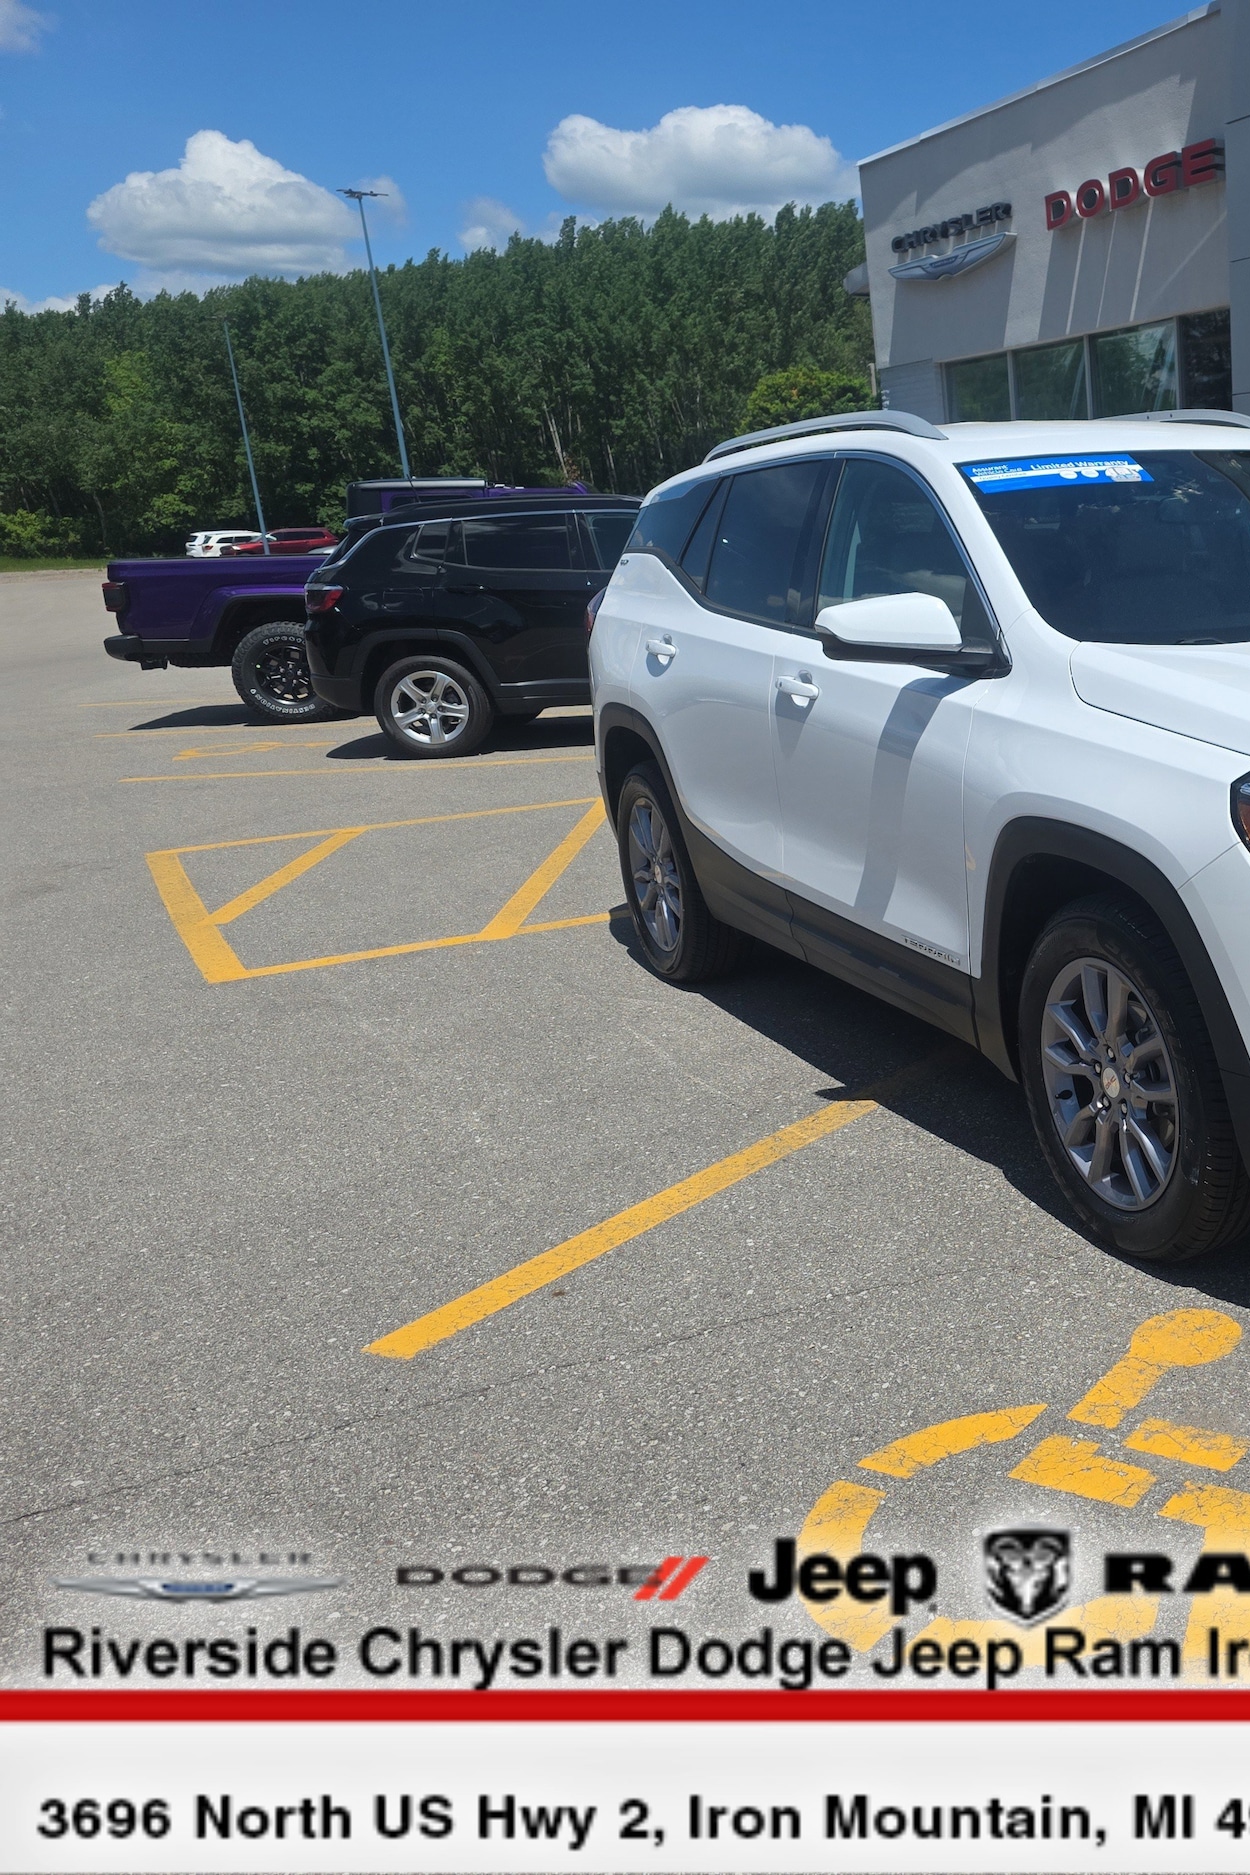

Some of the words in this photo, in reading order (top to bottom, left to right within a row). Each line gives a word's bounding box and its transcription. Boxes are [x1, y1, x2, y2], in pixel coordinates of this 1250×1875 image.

[1045, 138, 1226, 231] DODGE
[892, 202, 1012, 253] CHRYSLER
[1030, 461, 1075, 471] Limited
[1076, 459, 1129, 468] Warranty
